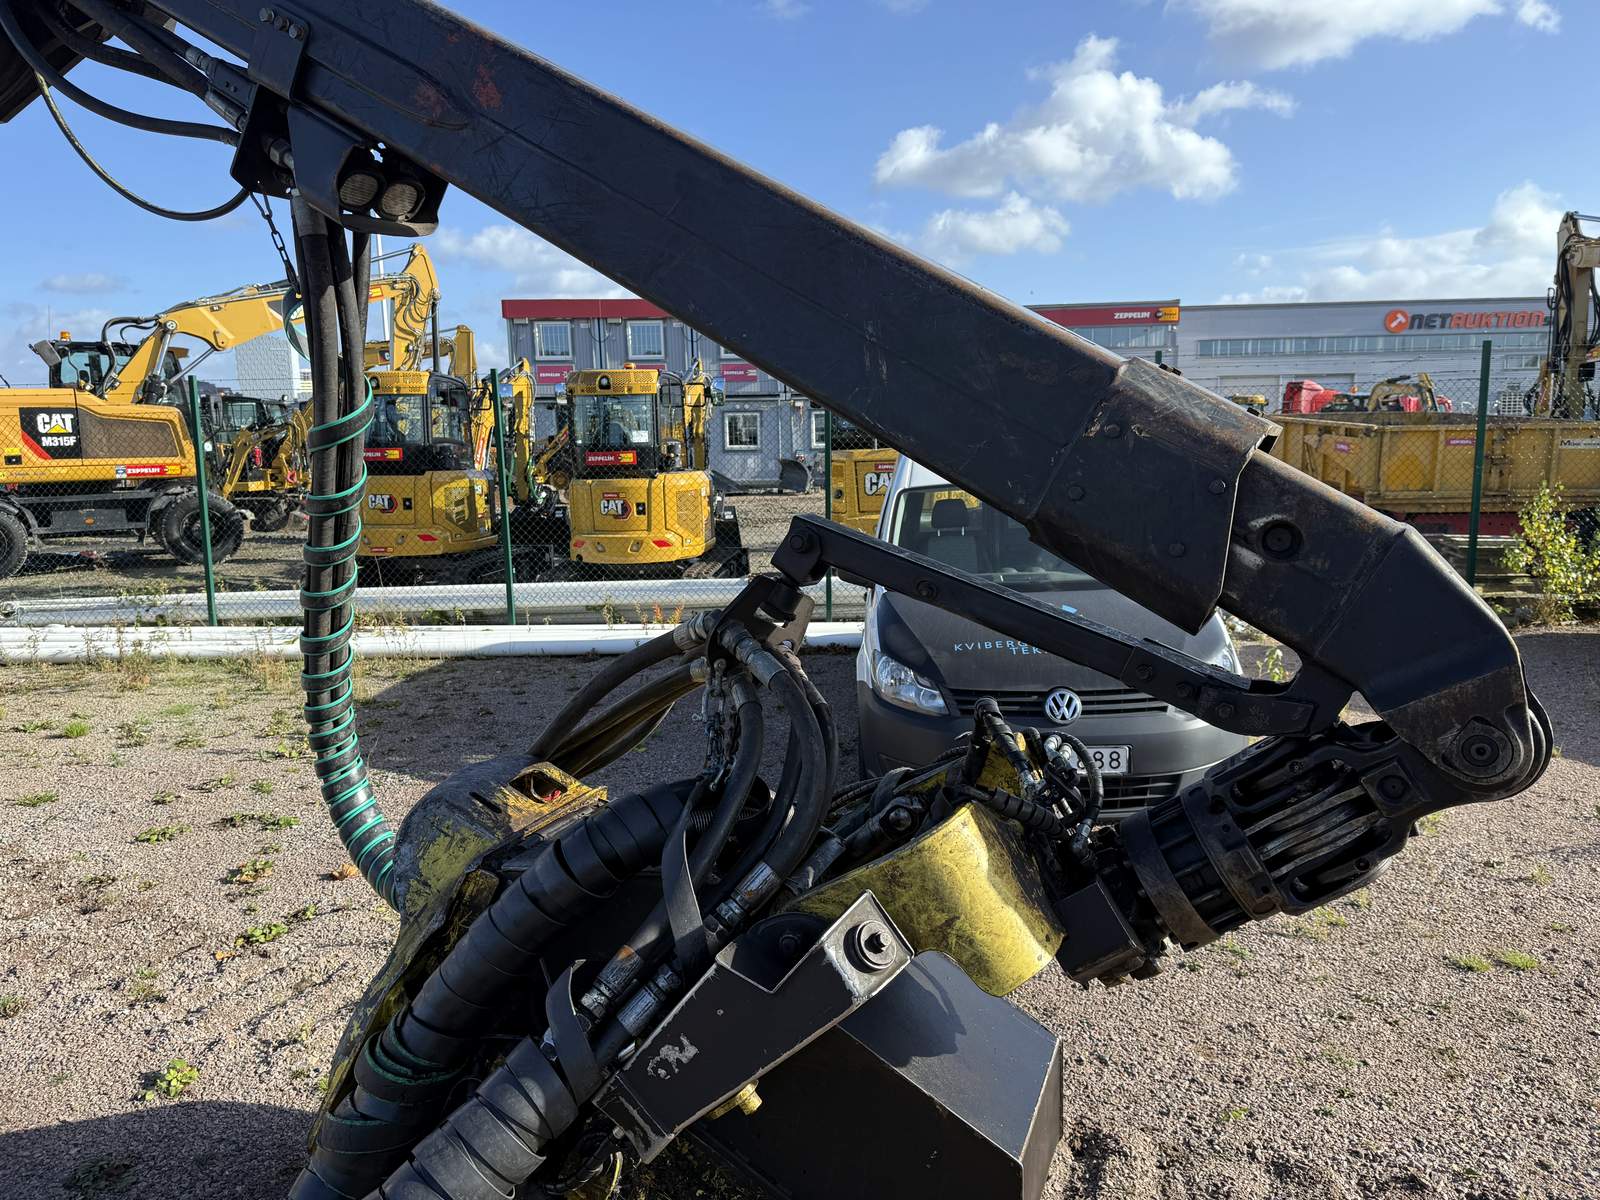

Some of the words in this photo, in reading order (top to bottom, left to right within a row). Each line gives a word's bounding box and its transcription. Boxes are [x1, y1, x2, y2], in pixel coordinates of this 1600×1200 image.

[1113, 311, 1151, 320] ZEPPELIN
[37, 413, 74, 433] CAT
[41, 436, 77, 447] M315F
[367, 494, 391, 509] CAT
[600, 499, 624, 515] CAT
